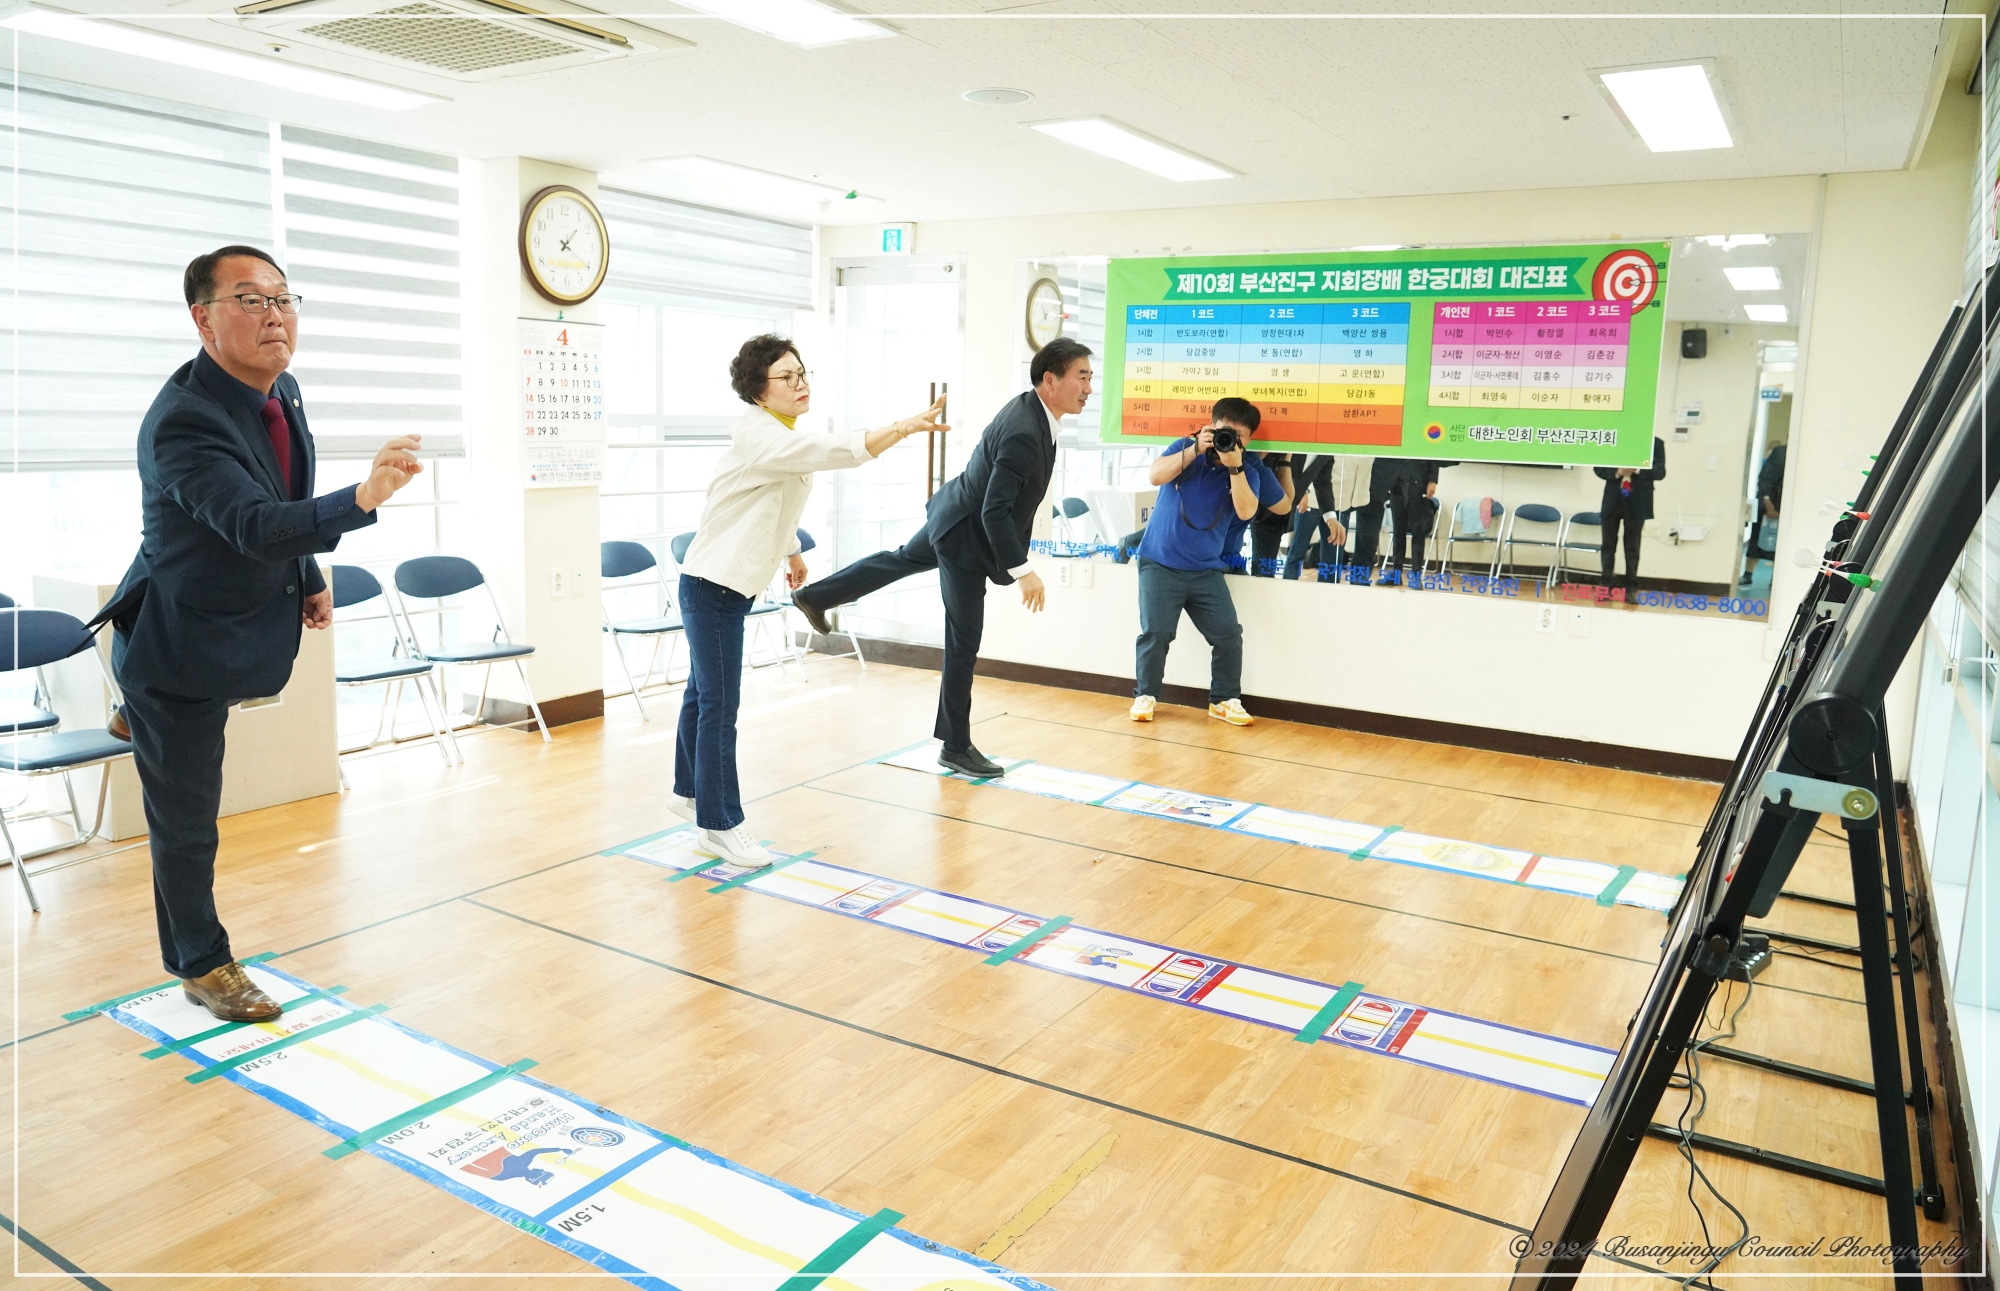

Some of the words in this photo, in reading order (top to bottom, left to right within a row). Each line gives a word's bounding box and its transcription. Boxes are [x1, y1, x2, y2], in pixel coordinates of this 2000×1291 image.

[546, 208, 554, 220] 11
[560, 203, 569, 216] 12
[537, 219, 546, 231] 10
[585, 223, 590, 235] 2
[533, 237, 540, 248] 9
[589, 242, 595, 254] 3
[538, 256, 545, 267] 8
[550, 270, 555, 281] 7
[564, 274, 570, 287] 6
[577, 272, 583, 284] 5
[1176, 272, 1235, 294] 제10회
[1239, 271, 1316, 293] 부산진구
[1320, 269, 1402, 292] 지회장배
[1408, 267, 1494, 291] 한궁대회
[1500, 266, 1568, 289] 대진표
[1134, 309, 1158, 320] 단체전
[1197, 309, 1215, 319] 코드
[1276, 308, 1295, 318] 코드
[1360, 307, 1379, 318] 코드
[1440, 306, 1470, 318] 개인전
[1494, 306, 1516, 317] 코드
[1546, 306, 1568, 317] 코드
[1598, 305, 1620, 316] 코드
[557, 328, 569, 346] 4
[1138, 329, 1153, 338] 1시합
[1261, 329, 1305, 338] 양정현대1차
[1342, 329, 1367, 338] 백양산
[1371, 329, 1388, 338] 쌍용
[1444, 328, 1463, 338] 1시합
[1486, 328, 1513, 338] 박민수
[1136, 348, 1153, 356] 2시합
[1186, 348, 1216, 357] 당감중앙
[1442, 350, 1463, 359] 2시합
[1535, 350, 1562, 360] 이영순
[550, 363, 555, 371] 2
[562, 362, 566, 371] 3
[572, 363, 578, 371] 4
[584, 364, 588, 372] 5
[594, 365, 599, 373] 6
[1135, 366, 1152, 374] 3시합
[1181, 367, 1201, 376] 가야2
[1204, 367, 1219, 376] 일심
[1282, 368, 1290, 377] 생
[1340, 369, 1348, 378] 고
[1441, 370, 1461, 380] 3시합
[1585, 372, 1613, 382] 김기수
[526, 378, 531, 386] 7
[538, 378, 543, 387] 8
[550, 379, 555, 387] 9
[560, 379, 568, 387] 10
[572, 379, 579, 388] 11
[583, 380, 591, 388] 12
[593, 380, 601, 389] 13
[1133, 385, 1151, 393] 4시합
[1197, 386, 1227, 395] 어반파크
[1252, 387, 1307, 397] 부녀복지(연합)
[1346, 389, 1376, 399] 당감1동
[525, 394, 534, 403] 14
[537, 394, 546, 403] 15
[549, 394, 557, 403] 16
[560, 395, 568, 403] 17
[572, 395, 580, 404] 18
[583, 395, 591, 404] 19
[593, 395, 602, 404] 20
[1439, 391, 1460, 401] 4시합
[1481, 392, 1508, 401] 최영숙
[1531, 392, 1559, 403] 이순자
[1133, 403, 1150, 412] 5시합
[1182, 404, 1197, 413] 개금
[1270, 407, 1277, 416] 다
[526, 410, 534, 419] 21
[537, 410, 546, 419] 22
[549, 411, 558, 420] 23
[560, 411, 569, 420] 24
[572, 411, 581, 420] 25
[583, 411, 591, 420] 26
[593, 411, 602, 420] 27
[1343, 409, 1377, 418] 삼환APT
[1132, 421, 1149, 430] 6시합
[1450, 424, 1466, 433] 사단
[525, 426, 535, 436] 28
[537, 427, 547, 436] 29
[549, 427, 559, 436] 30
[1469, 426, 1532, 442] 대한노인회
[1536, 429, 1616, 445] 부산진구지회
[1450, 434, 1465, 442] 법인
[1258, 557, 1285, 576] 전문
[1316, 562, 1372, 585] 국가검진,
[1379, 569, 1401, 585] 5대
[1460, 574, 1519, 597] 건강검진
[1562, 583, 1627, 605] 진료문의
[1637, 590, 1766, 616] 051)638-8000
[121, 990, 169, 1010] 3.0M
[240, 1051, 288, 1073] 2.5M
[510, 1105, 562, 1132] Hands
[381, 1120, 431, 1146] 2.0M
[427, 1106, 529, 1159] 대한한궁협회
[447, 1131, 508, 1166] Archery
[557, 1203, 606, 1233] 1.5M
